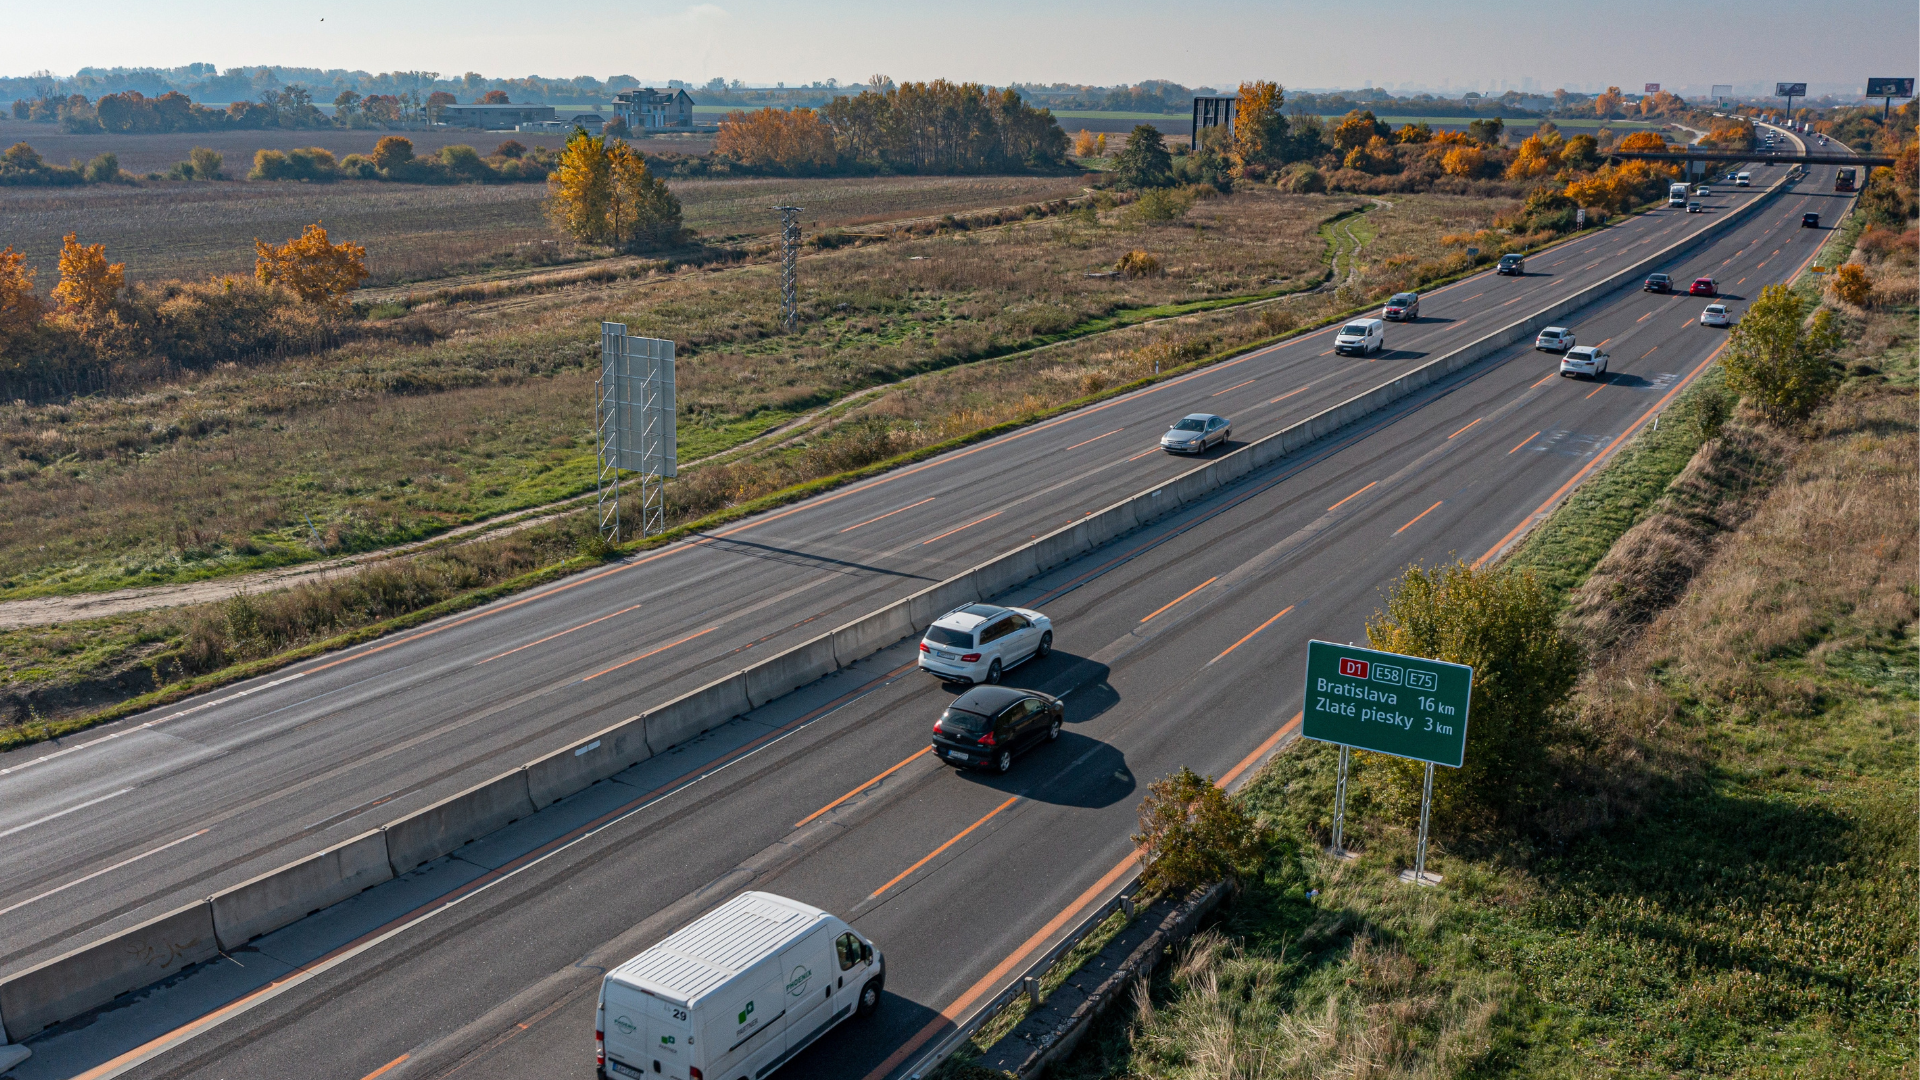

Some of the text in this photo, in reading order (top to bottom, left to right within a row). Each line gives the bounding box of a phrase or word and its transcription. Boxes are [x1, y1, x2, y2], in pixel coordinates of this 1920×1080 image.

[1346, 662, 1433, 687] D1 E58 E75
[1317, 677, 1455, 716] Bratislava 16 km
[1315, 697, 1453, 735] Zlaté piesky 3 km
[786, 969, 812, 992] PHOENIX
[672, 1008, 687, 1021] 29
